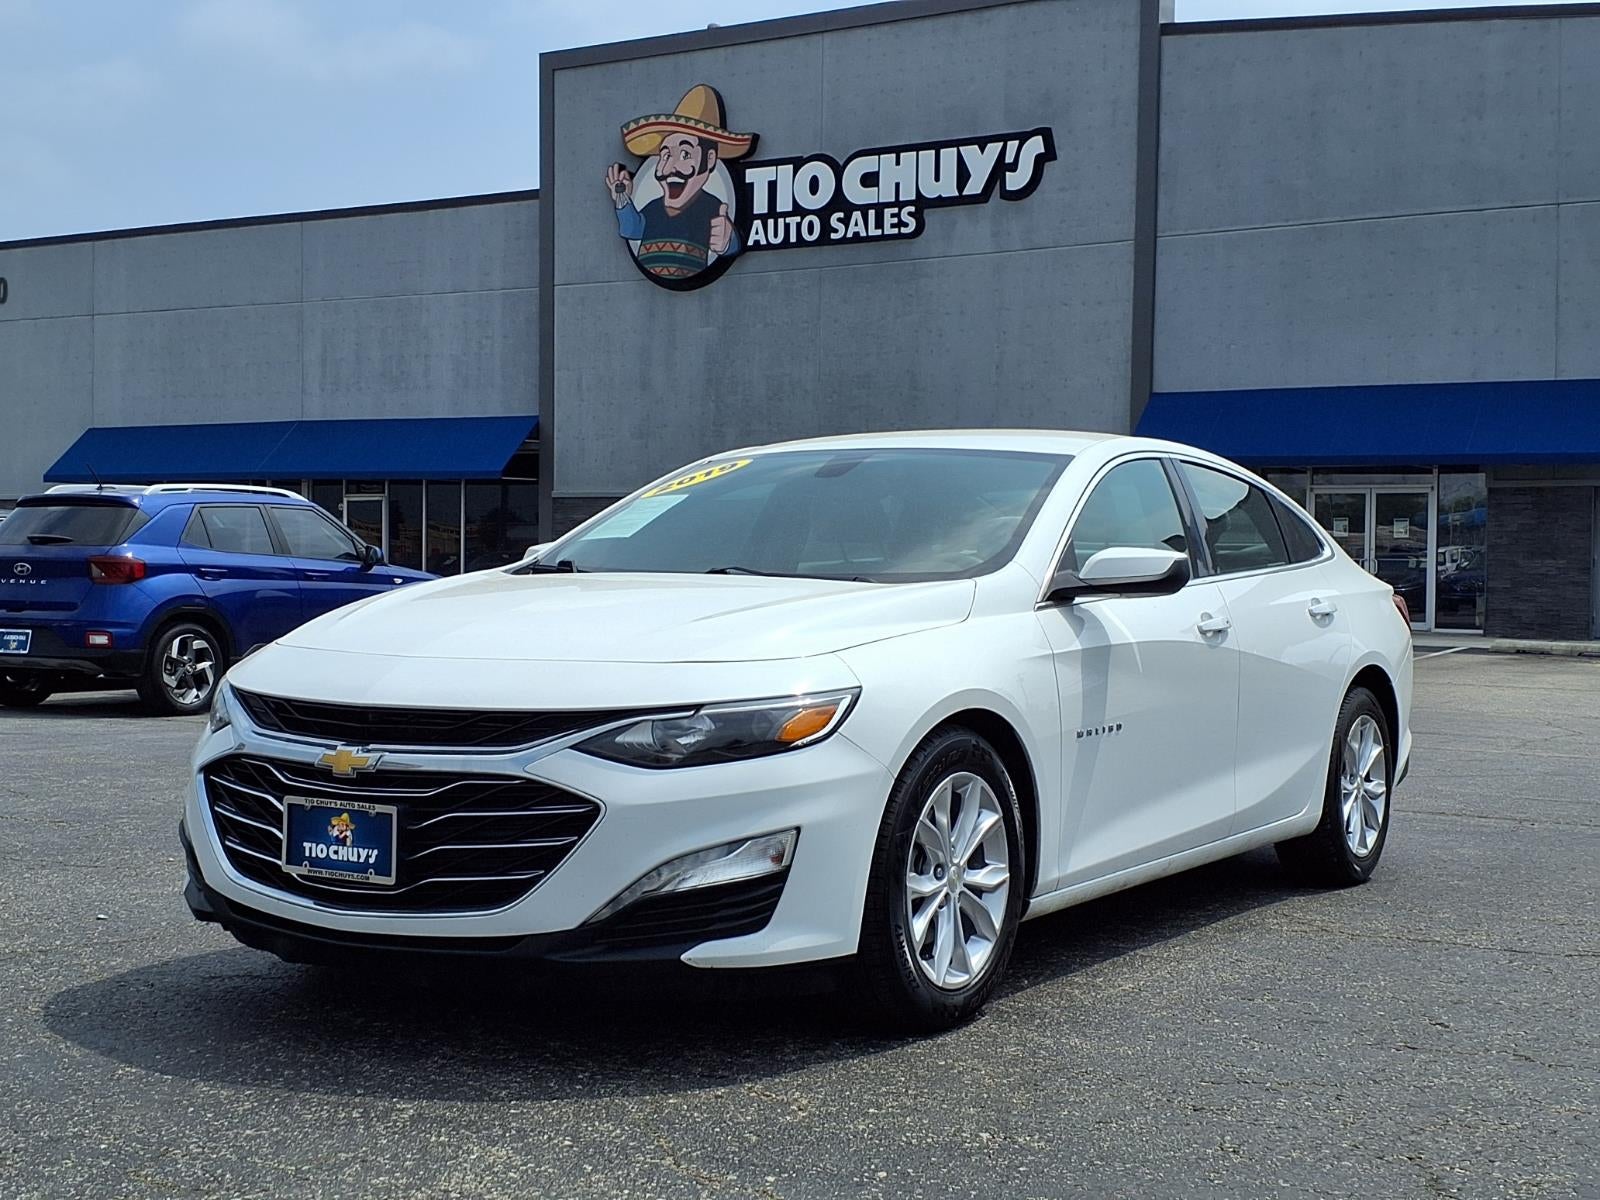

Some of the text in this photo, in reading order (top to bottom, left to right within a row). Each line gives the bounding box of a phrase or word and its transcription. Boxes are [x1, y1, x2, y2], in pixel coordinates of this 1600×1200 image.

[746, 135, 1046, 215] TIO CHUY'S
[747, 205, 916, 246] AUTO SALES
[652, 462, 739, 496] 2019
[304, 797, 376, 811] TIO CHUY'S AUTO SALES
[303, 842, 378, 864] TIO CHUY'S
